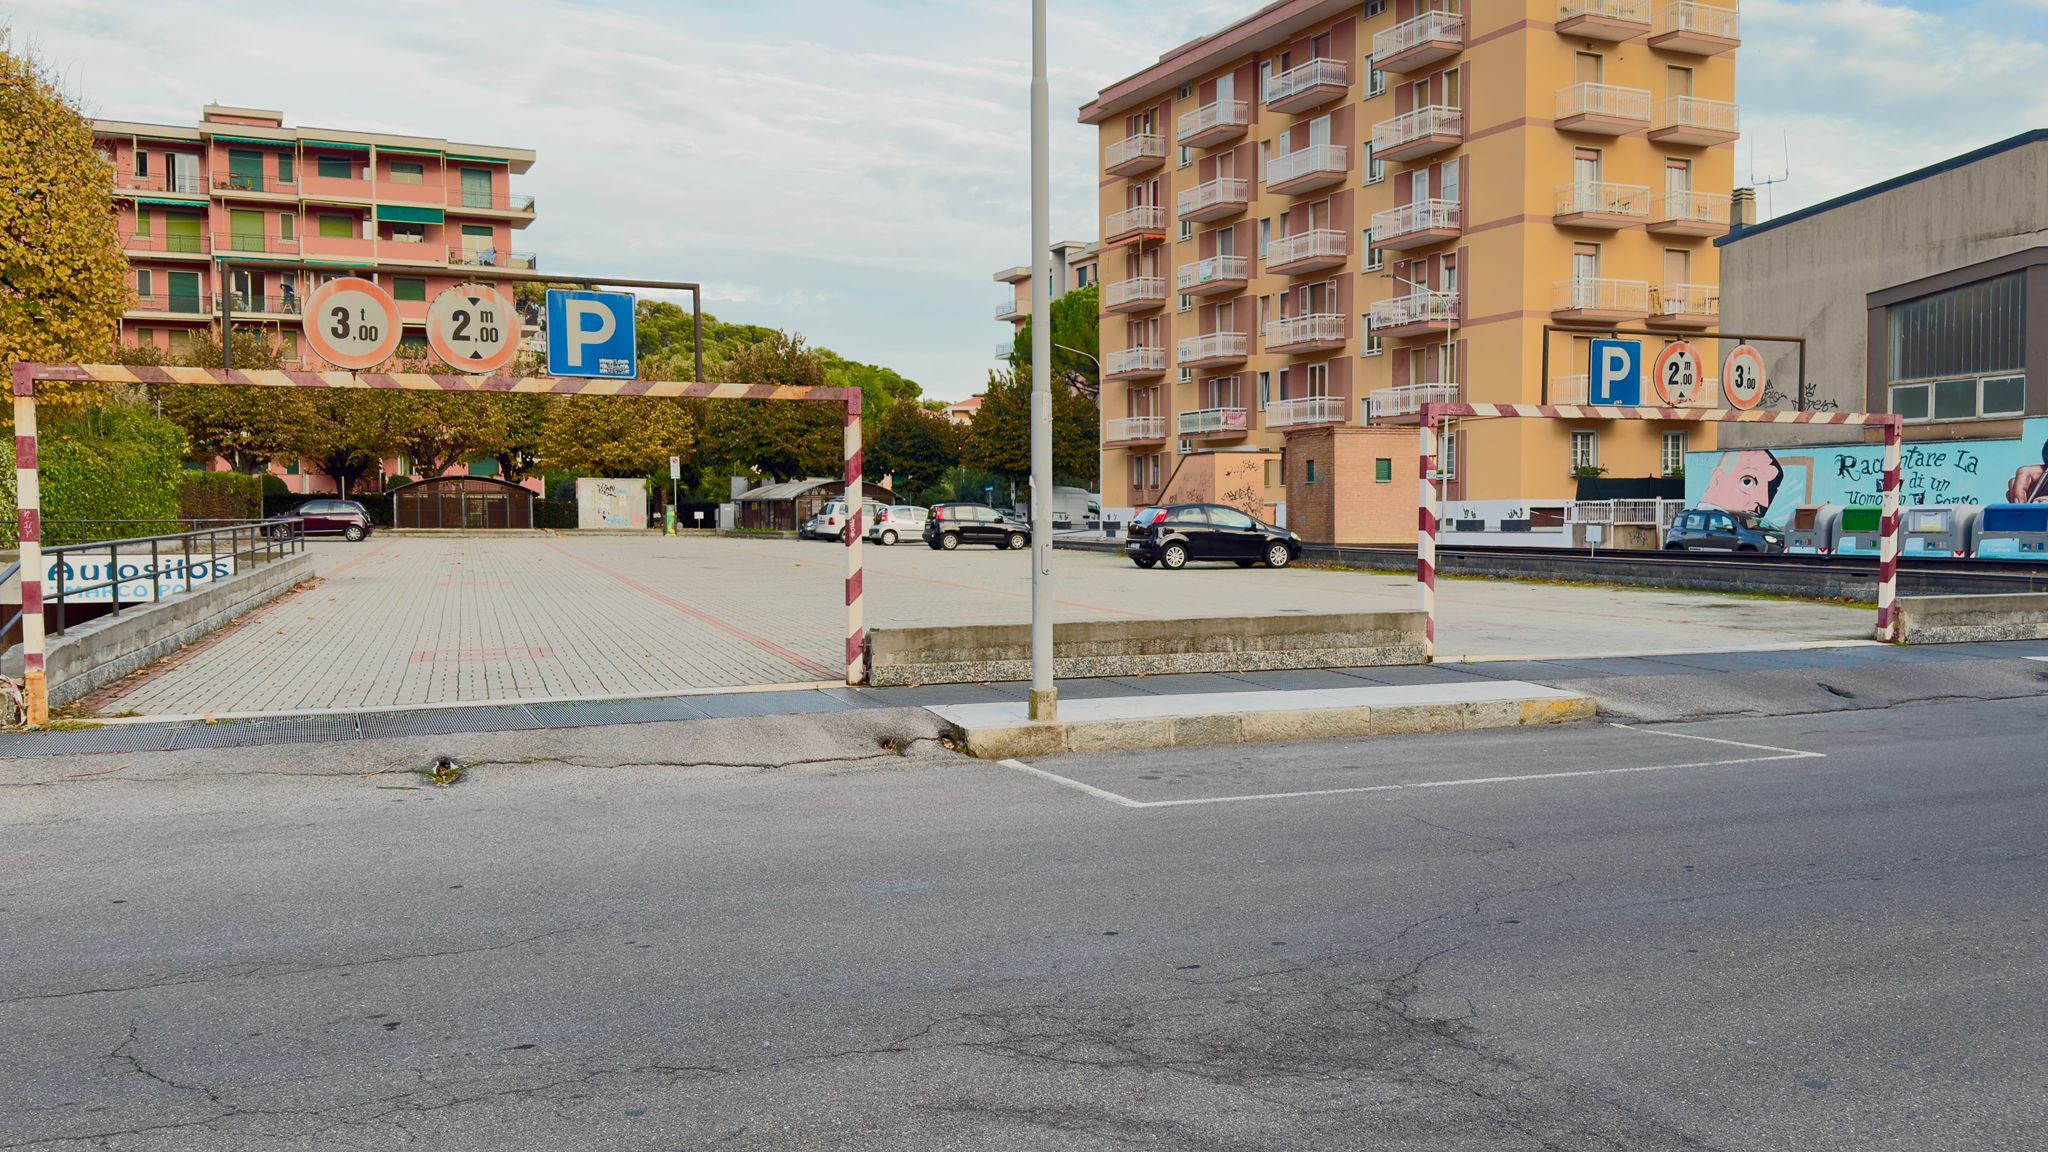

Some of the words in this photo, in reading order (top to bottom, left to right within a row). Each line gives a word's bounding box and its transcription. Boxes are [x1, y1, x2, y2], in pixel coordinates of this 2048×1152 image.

[480, 310, 494, 323] m
[566, 299, 616, 366] P
[1601, 346, 1631, 399] P
[1954, 450, 1978, 475] La
[1909, 471, 1926, 489] di
